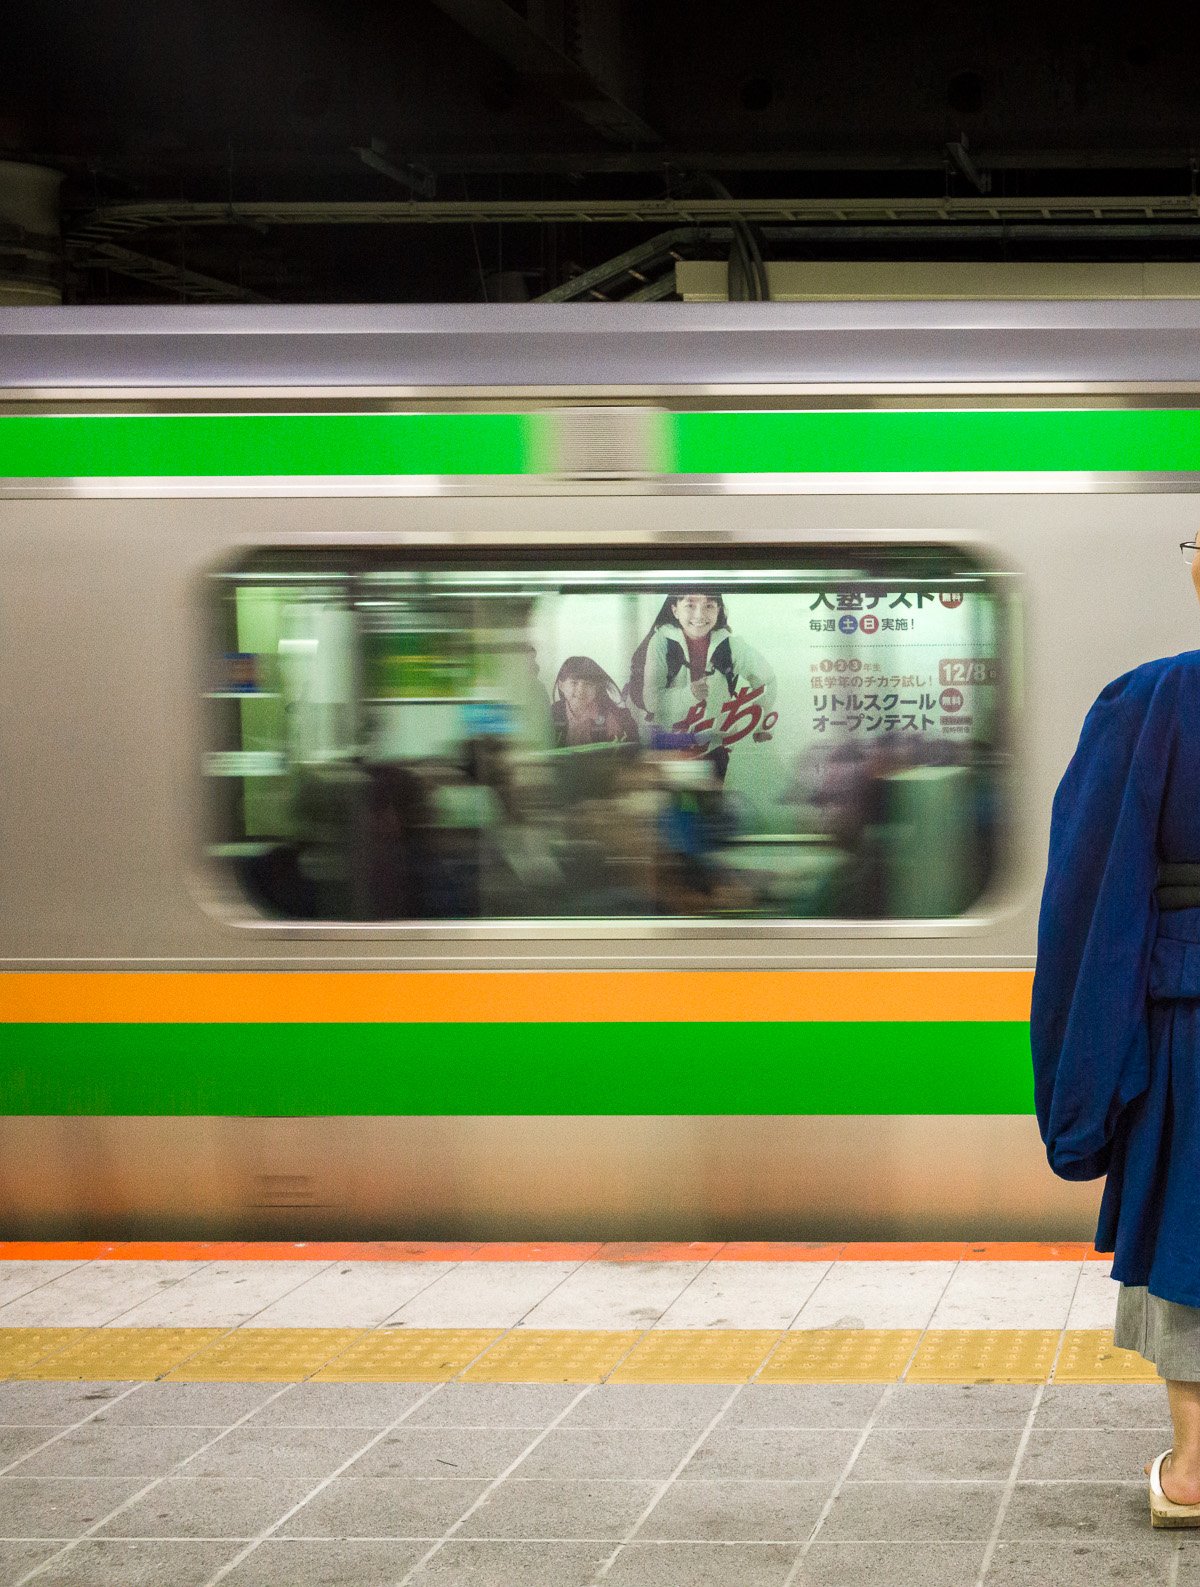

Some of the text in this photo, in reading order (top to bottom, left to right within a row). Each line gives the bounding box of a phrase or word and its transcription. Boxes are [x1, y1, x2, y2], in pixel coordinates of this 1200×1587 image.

[813, 694, 937, 712] リトルスクール
[812, 713, 935, 732] オープンテスト
